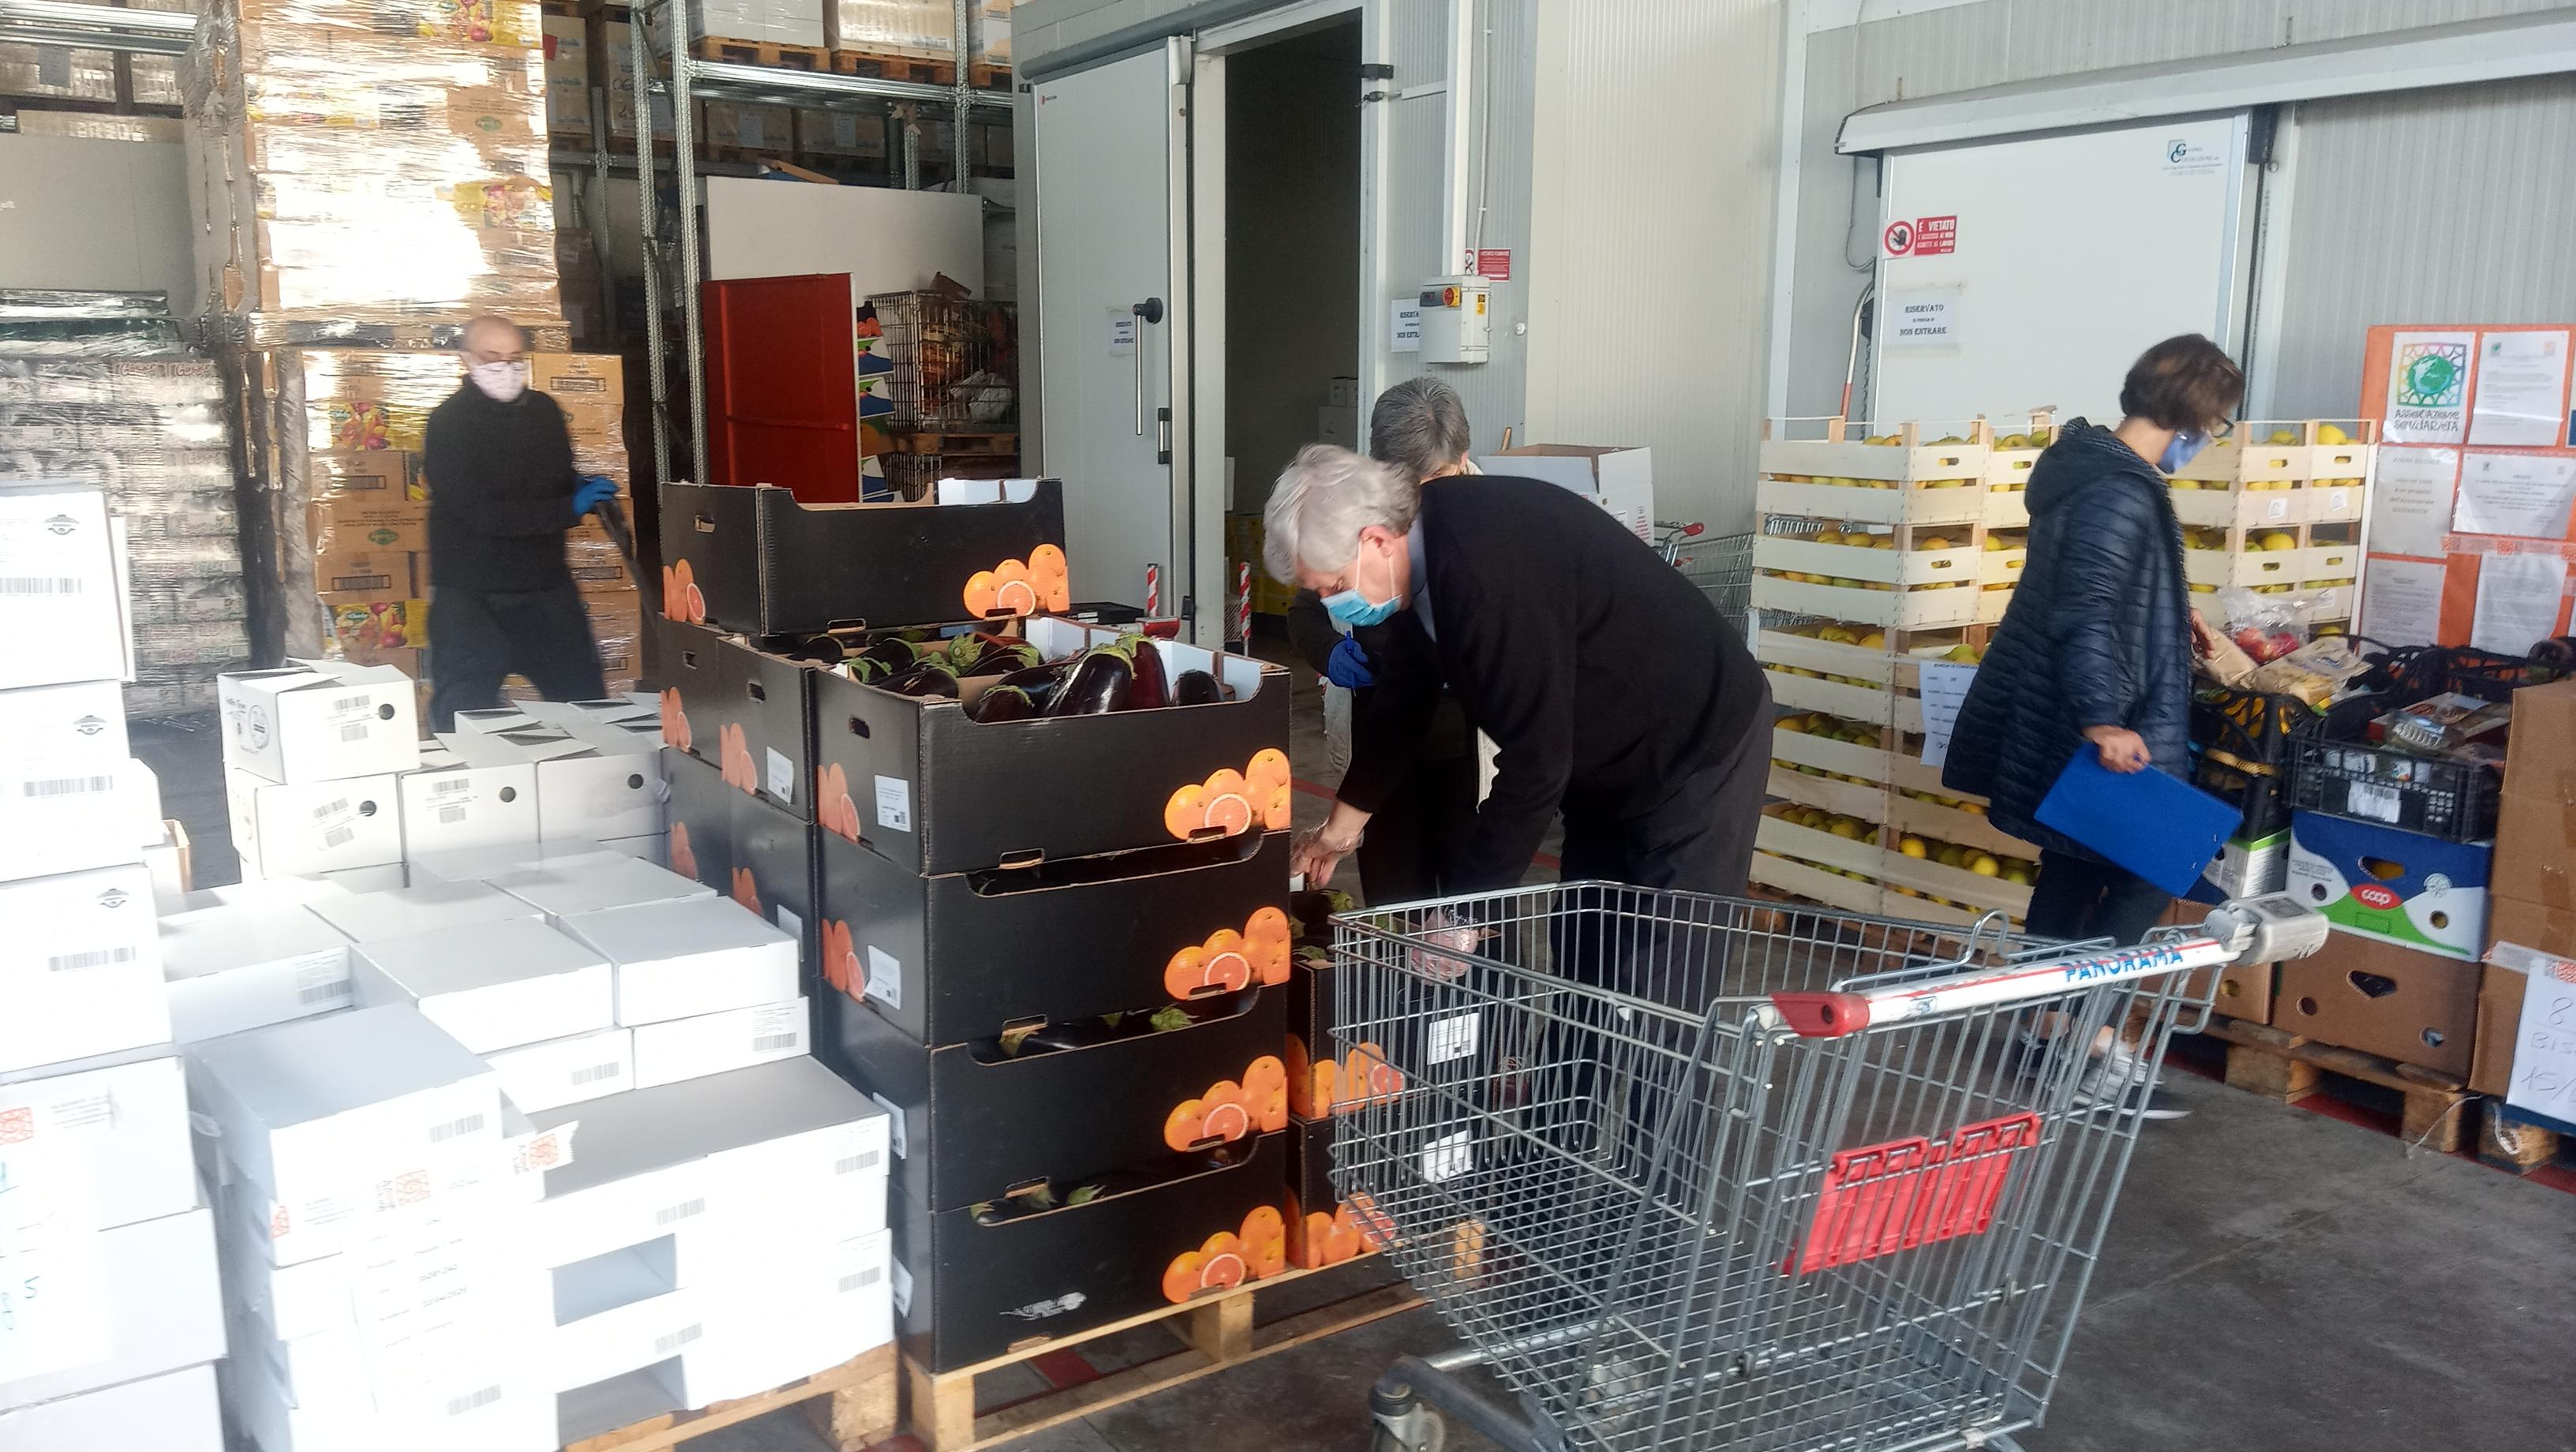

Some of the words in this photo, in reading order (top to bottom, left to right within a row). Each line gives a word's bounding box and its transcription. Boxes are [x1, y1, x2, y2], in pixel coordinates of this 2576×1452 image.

[1928, 219, 1955, 232] VIETATO
[1904, 304, 1945, 313] RISERVATO
[1914, 327, 1947, 335] ENTRARE
[2065, 949, 2184, 982] PANORAMA
